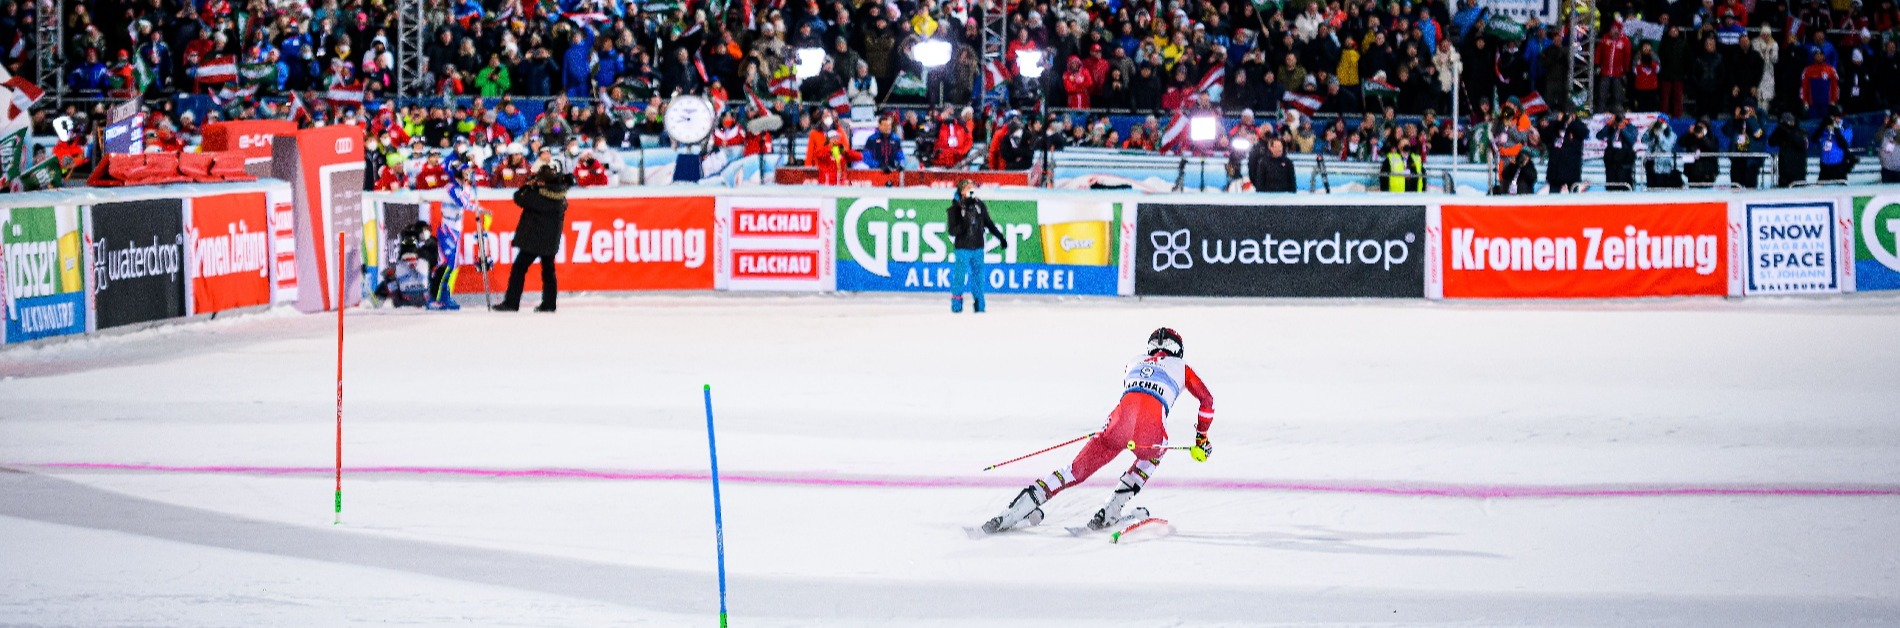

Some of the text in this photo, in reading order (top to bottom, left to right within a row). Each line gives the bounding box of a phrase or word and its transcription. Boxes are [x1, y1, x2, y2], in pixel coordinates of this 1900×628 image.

[738, 213, 812, 232] FLACHAU
[1759, 213, 1824, 223] FLACHAU
[843, 198, 1032, 277] Göser
[1759, 224, 1824, 241] SNOW
[571, 218, 706, 268] Zeitung
[1451, 228, 1577, 271] Kronen
[1582, 225, 1717, 275] Zeitung
[1760, 242, 1825, 251] WAGRAIN
[738, 255, 812, 274] FLACHAU
[1760, 252, 1826, 269] SPACE
[904, 267, 1074, 290] ALKOLFREI
[1760, 269, 1826, 280] ST. JOHANN
[1761, 283, 1826, 291] SALZBURG
